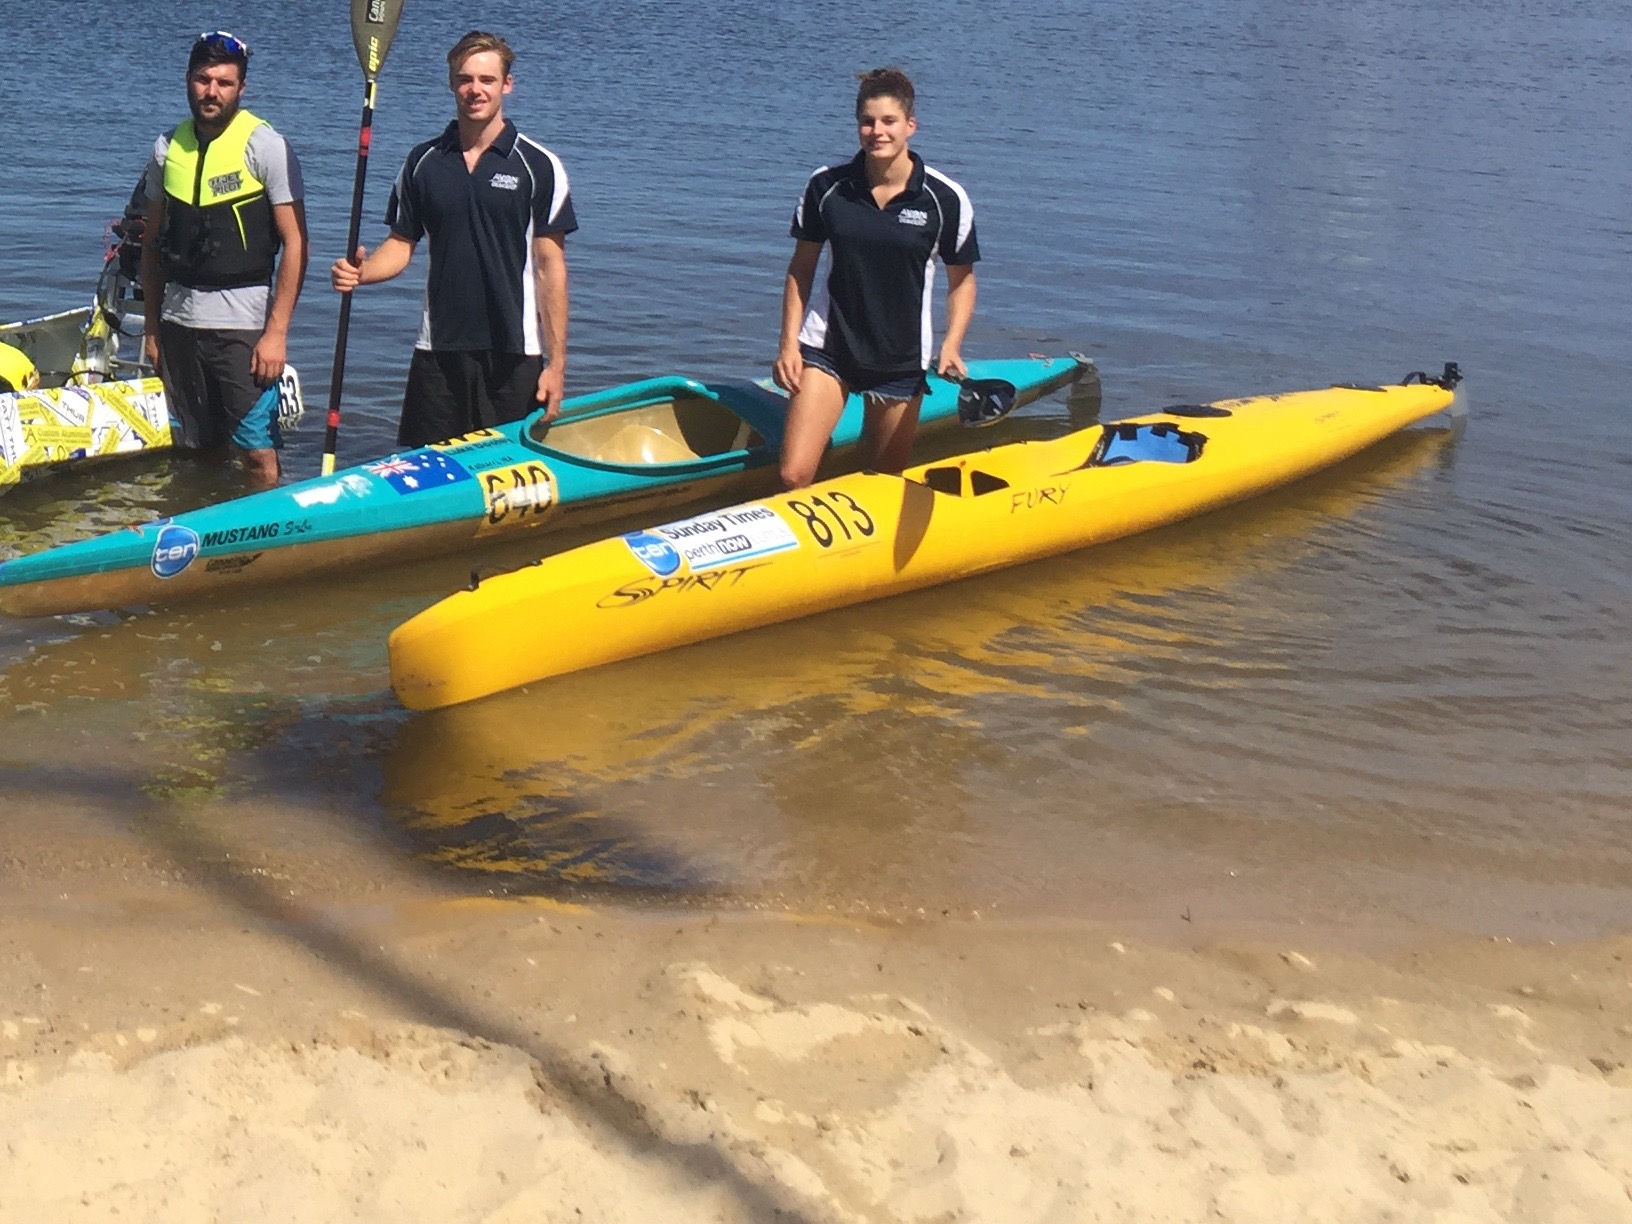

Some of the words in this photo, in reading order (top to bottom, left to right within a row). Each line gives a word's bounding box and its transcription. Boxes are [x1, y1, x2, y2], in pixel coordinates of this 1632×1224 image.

[369, 35, 379, 72] epic
[485, 465, 551, 525] 640
[1010, 481, 1072, 514] FURY
[201, 522, 280, 548] MUSTANG
[659, 516, 727, 541] Sunday
[723, 506, 775, 527] Times
[786, 491, 875, 548] 813
[155, 542, 197, 563] ten
[631, 540, 677, 558] ten
[684, 544, 719, 562] perth
[720, 536, 750, 553] now
[596, 561, 773, 609] SPIRIT
